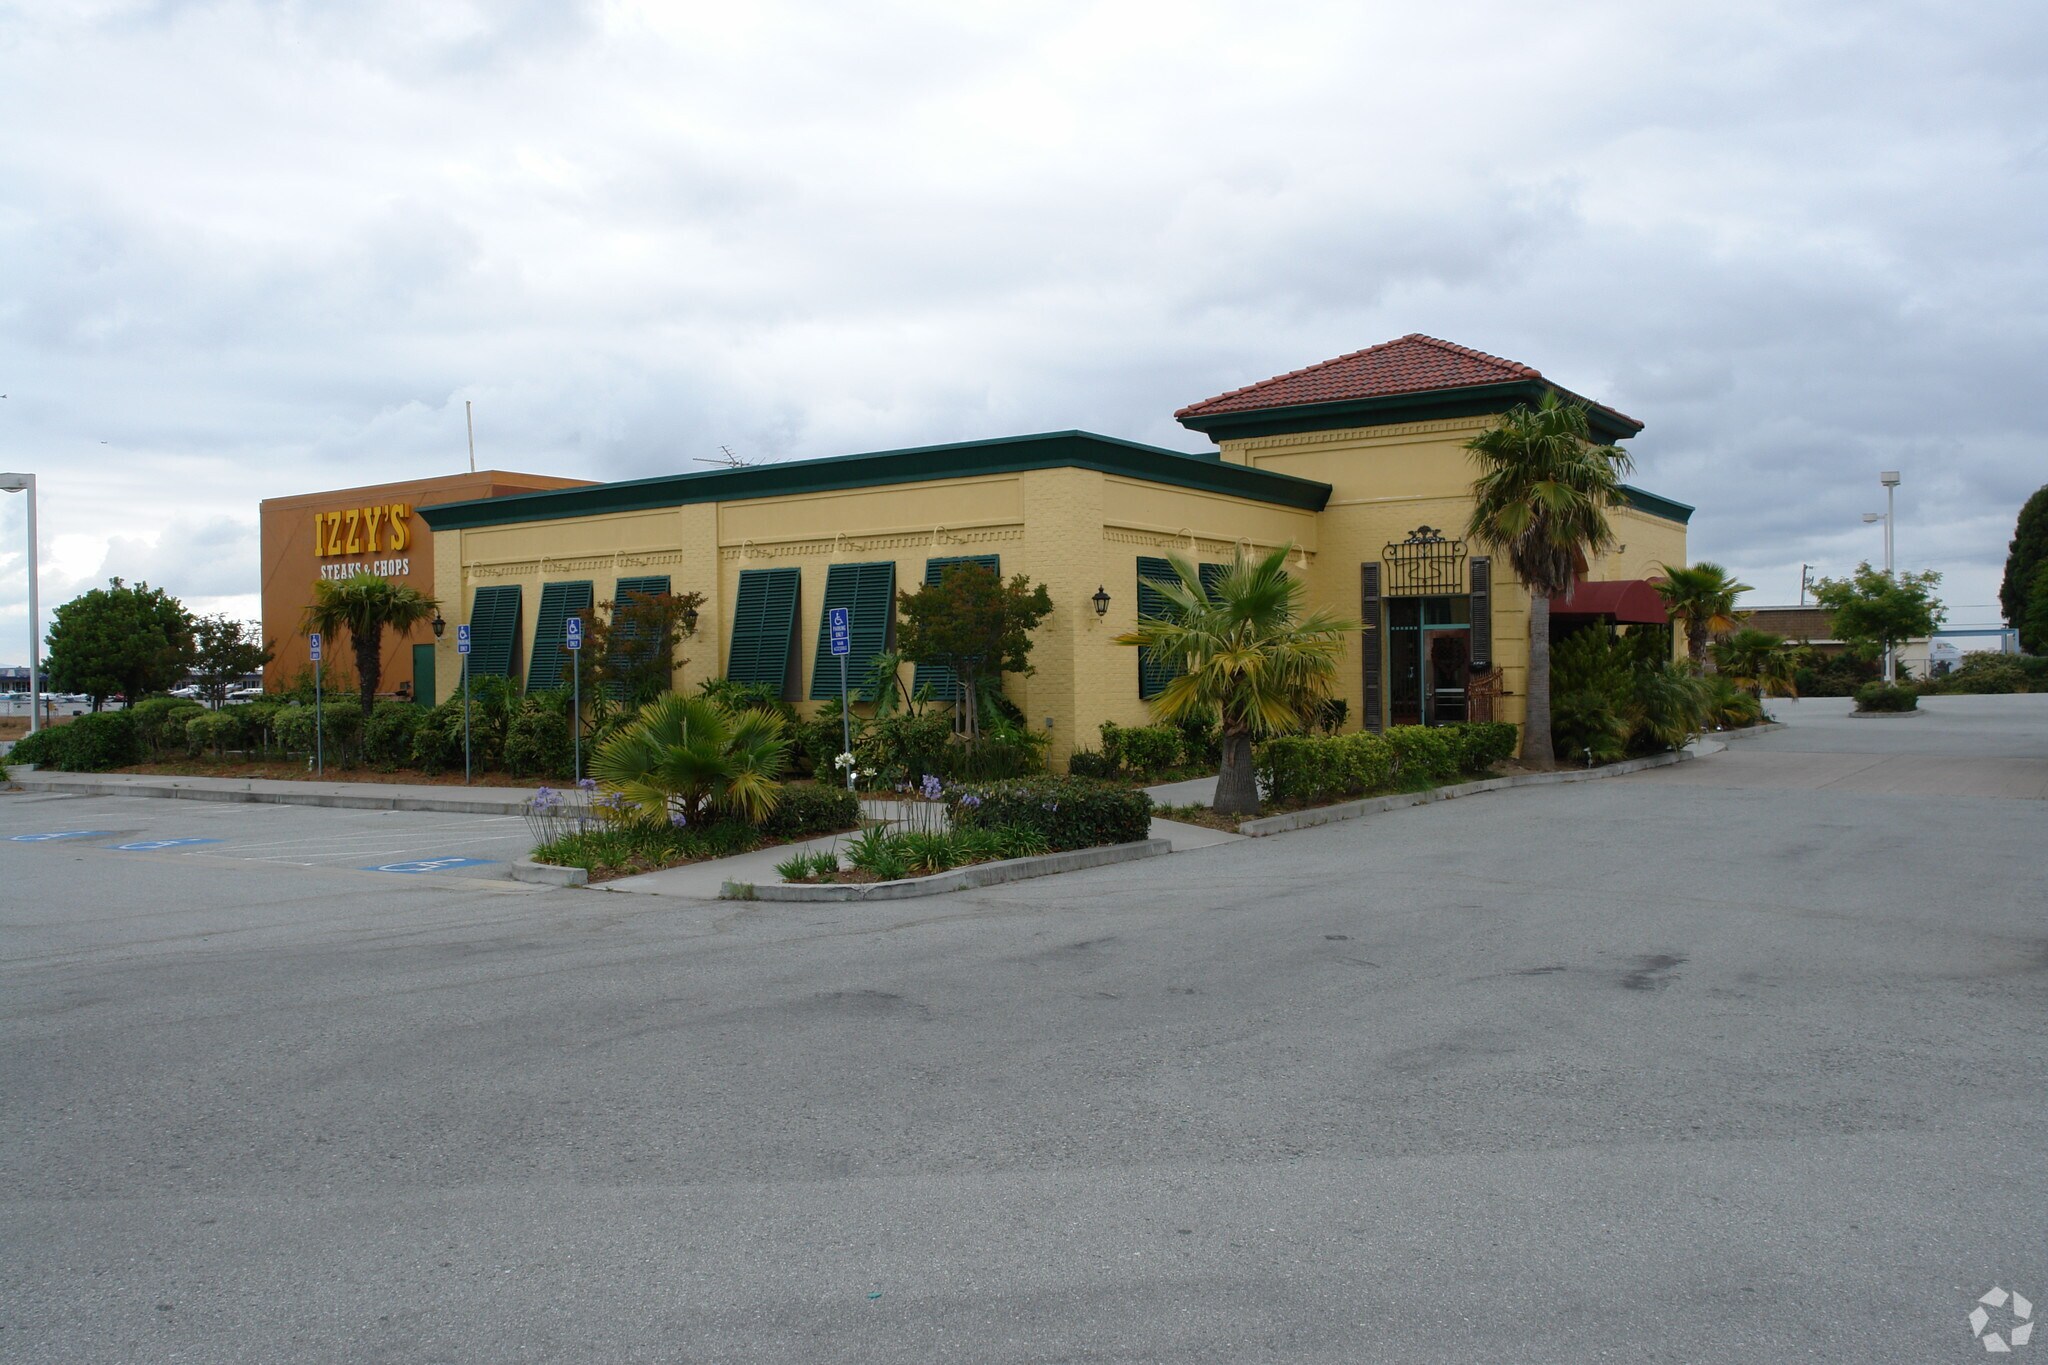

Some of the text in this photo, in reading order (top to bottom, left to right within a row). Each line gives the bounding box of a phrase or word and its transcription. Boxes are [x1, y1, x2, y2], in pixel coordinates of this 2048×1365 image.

[314, 503, 410, 557] IZZY'S
[320, 558, 409, 580] STEAKS & CHOPS
